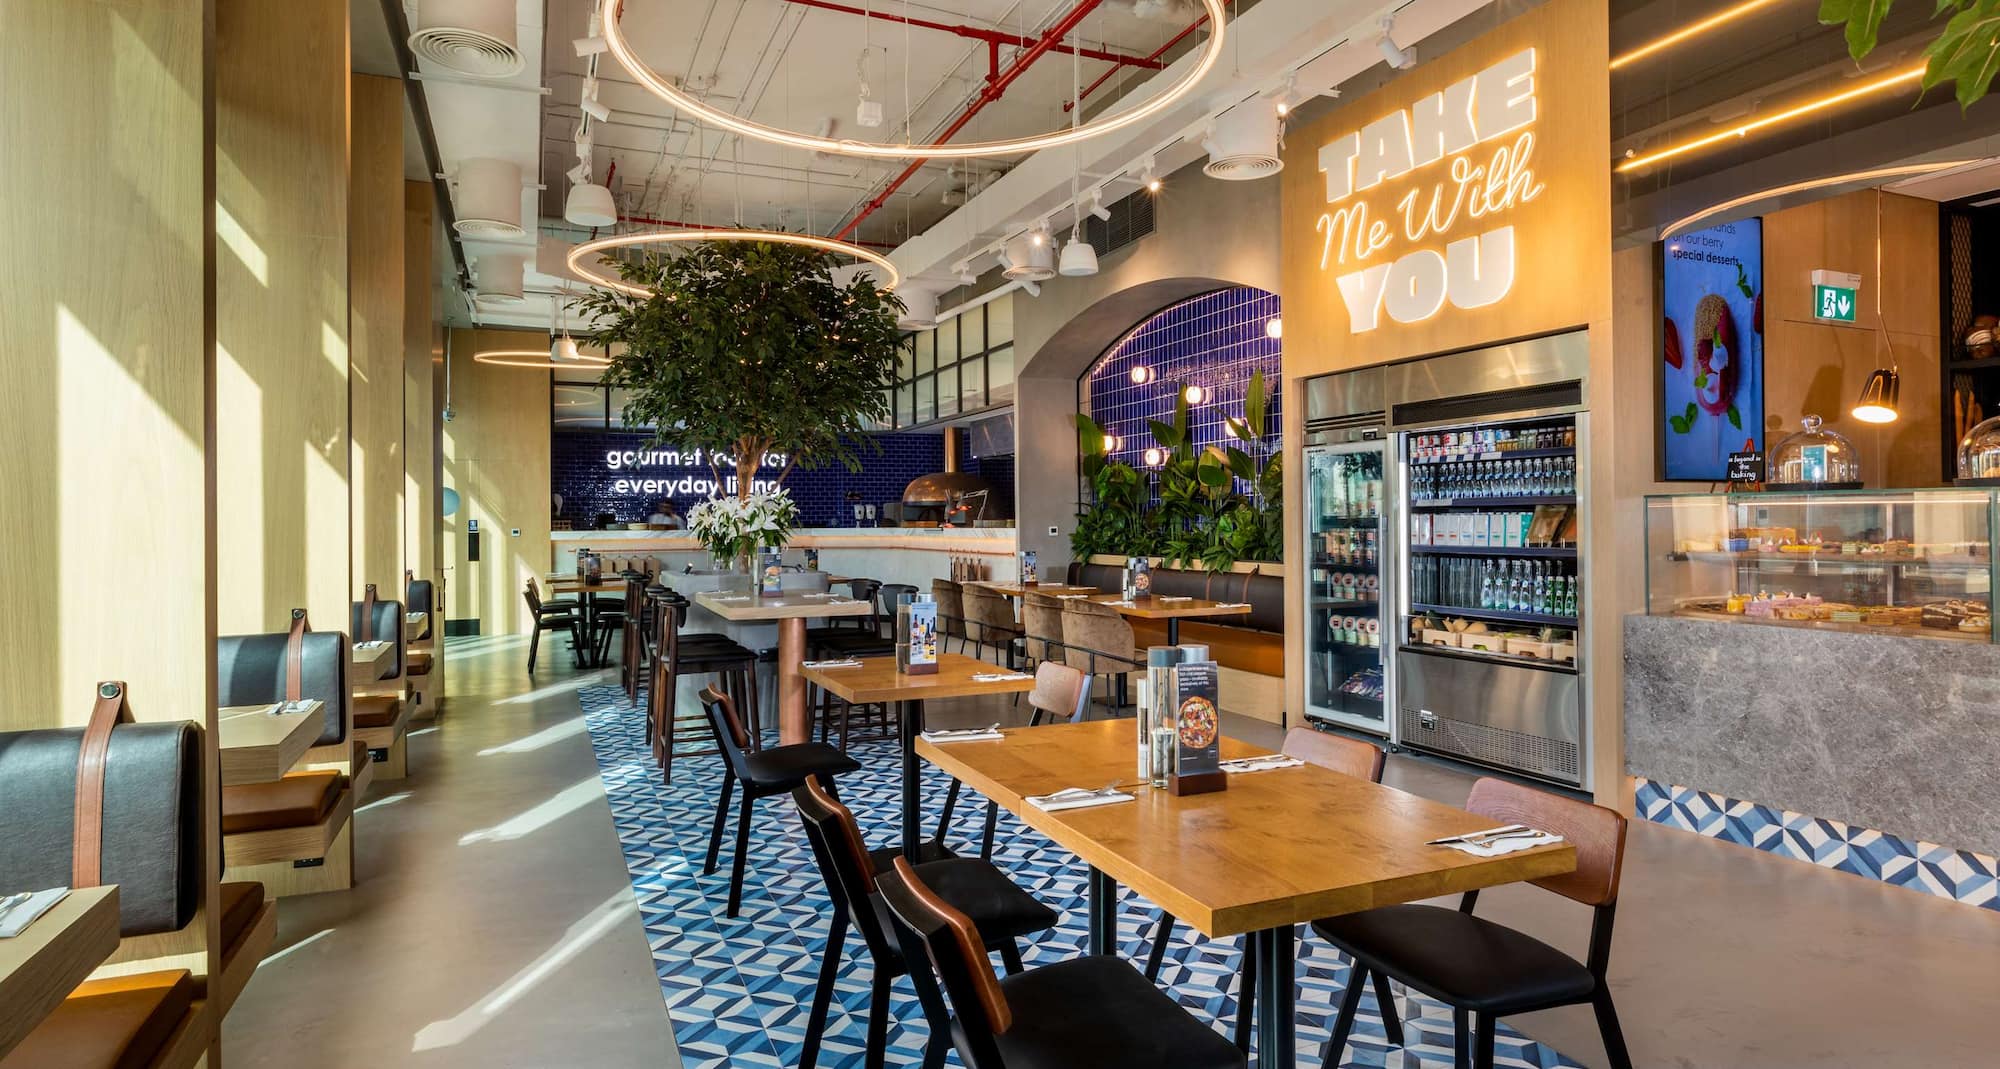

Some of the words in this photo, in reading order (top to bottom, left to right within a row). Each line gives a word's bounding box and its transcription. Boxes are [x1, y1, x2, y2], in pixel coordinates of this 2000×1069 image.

[1318, 47, 1537, 203] TAKE
[1316, 200, 1393, 271] Me
[1397, 131, 1546, 242] With
[1686, 235, 1701, 245] our
[1702, 234, 1725, 251] berry
[1673, 249, 1704, 262] special
[1336, 225, 1516, 335] YOU
[606, 447, 702, 470] gourmet
[615, 475, 720, 498] everyday
[1730, 470, 1757, 481] baking
